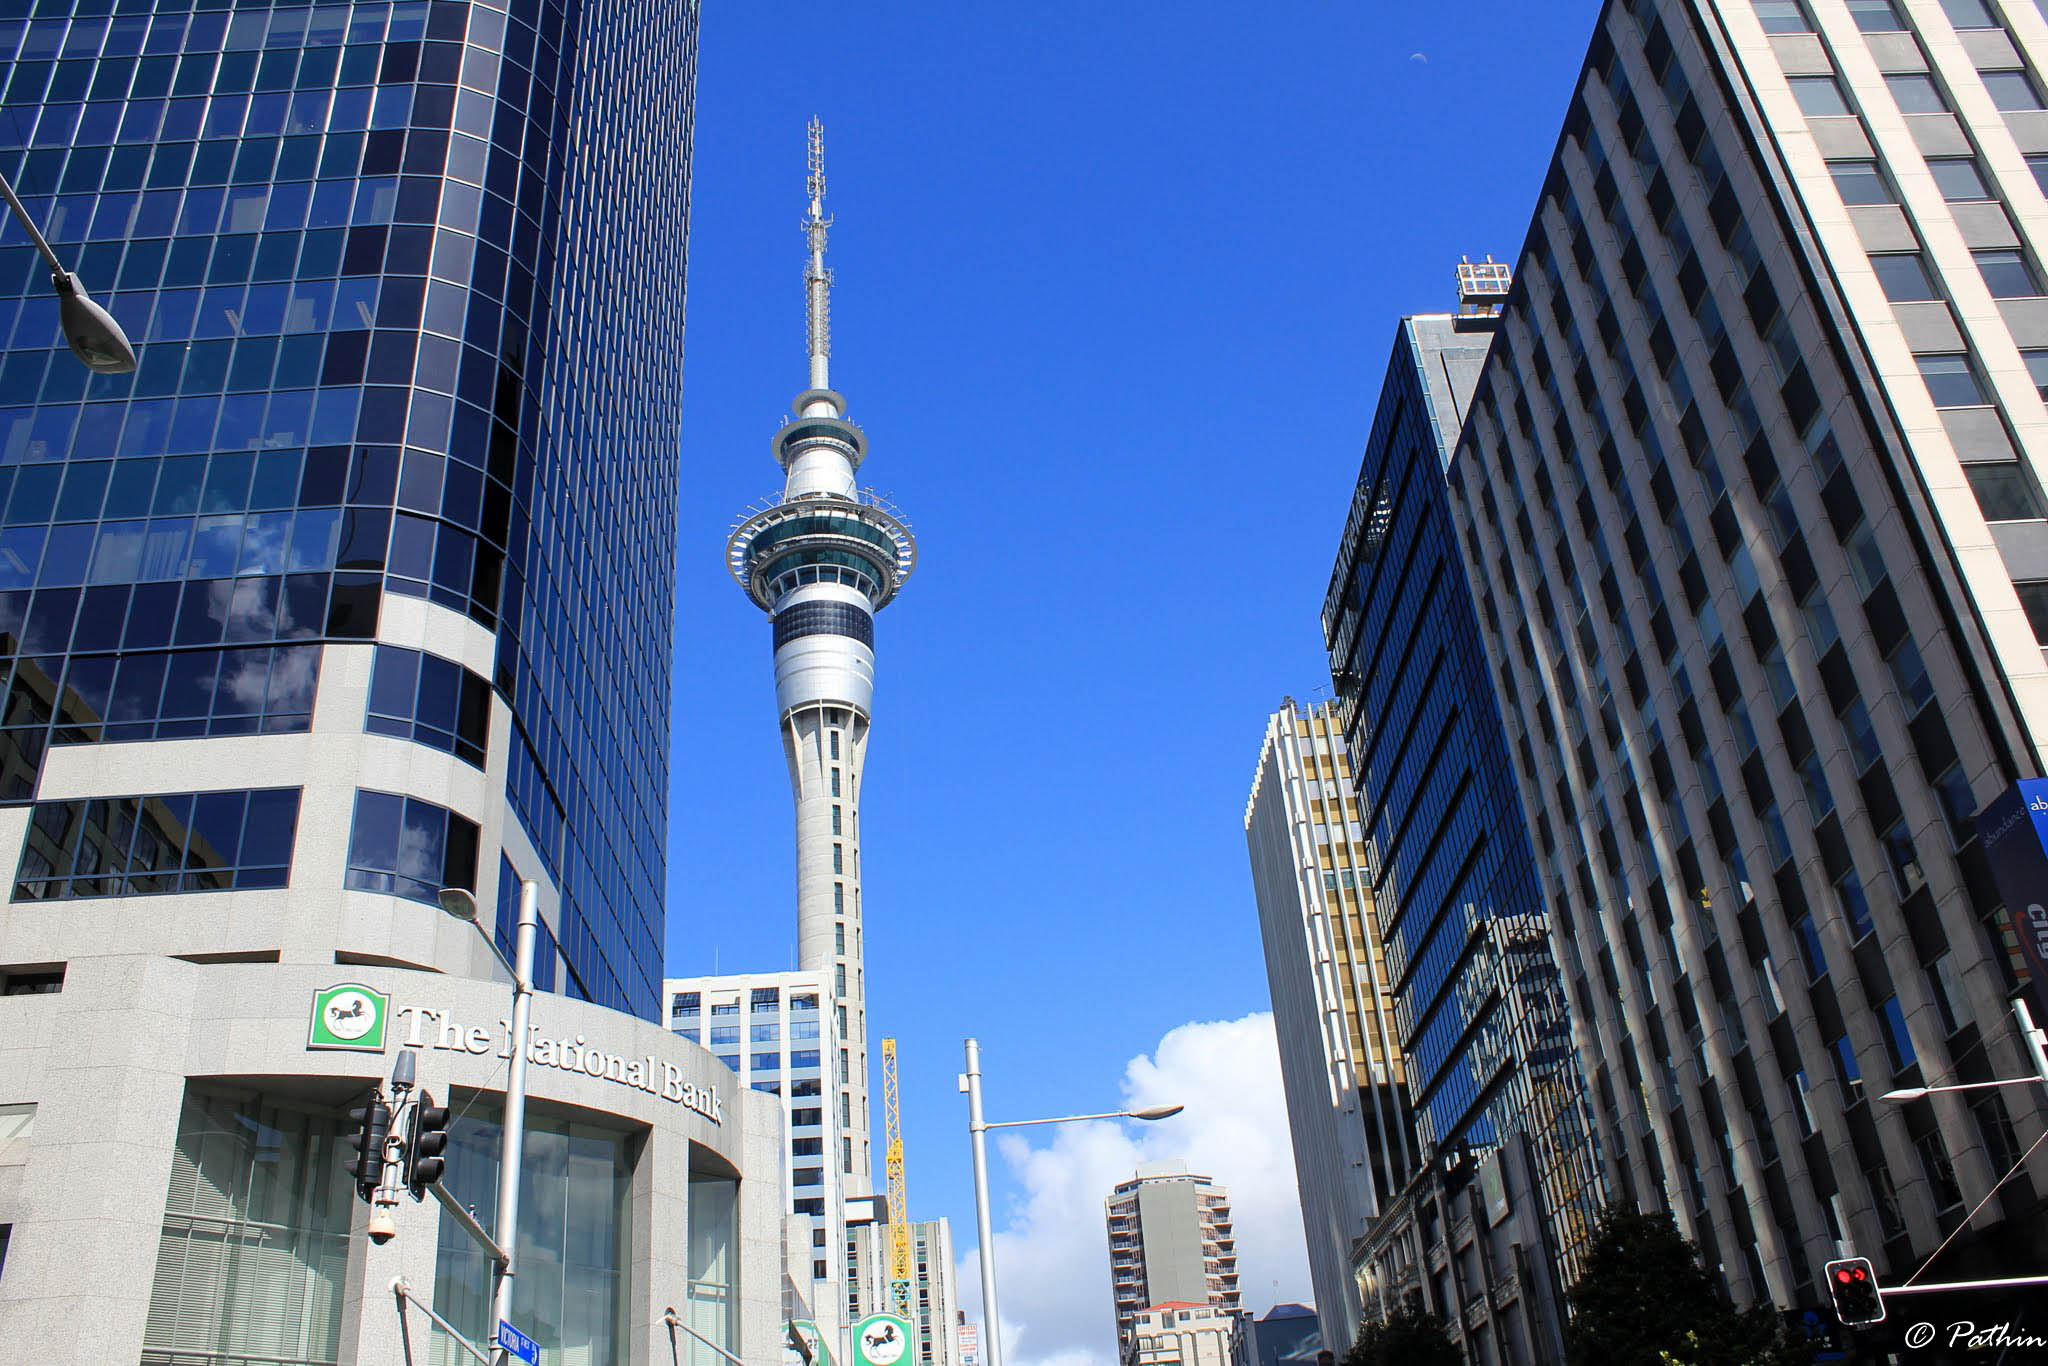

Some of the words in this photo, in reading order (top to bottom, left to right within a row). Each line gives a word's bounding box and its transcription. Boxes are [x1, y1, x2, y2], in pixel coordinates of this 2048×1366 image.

[397, 1004, 489, 1054] The
[499, 1018, 657, 1094] National
[660, 1059, 724, 1127] Bank
